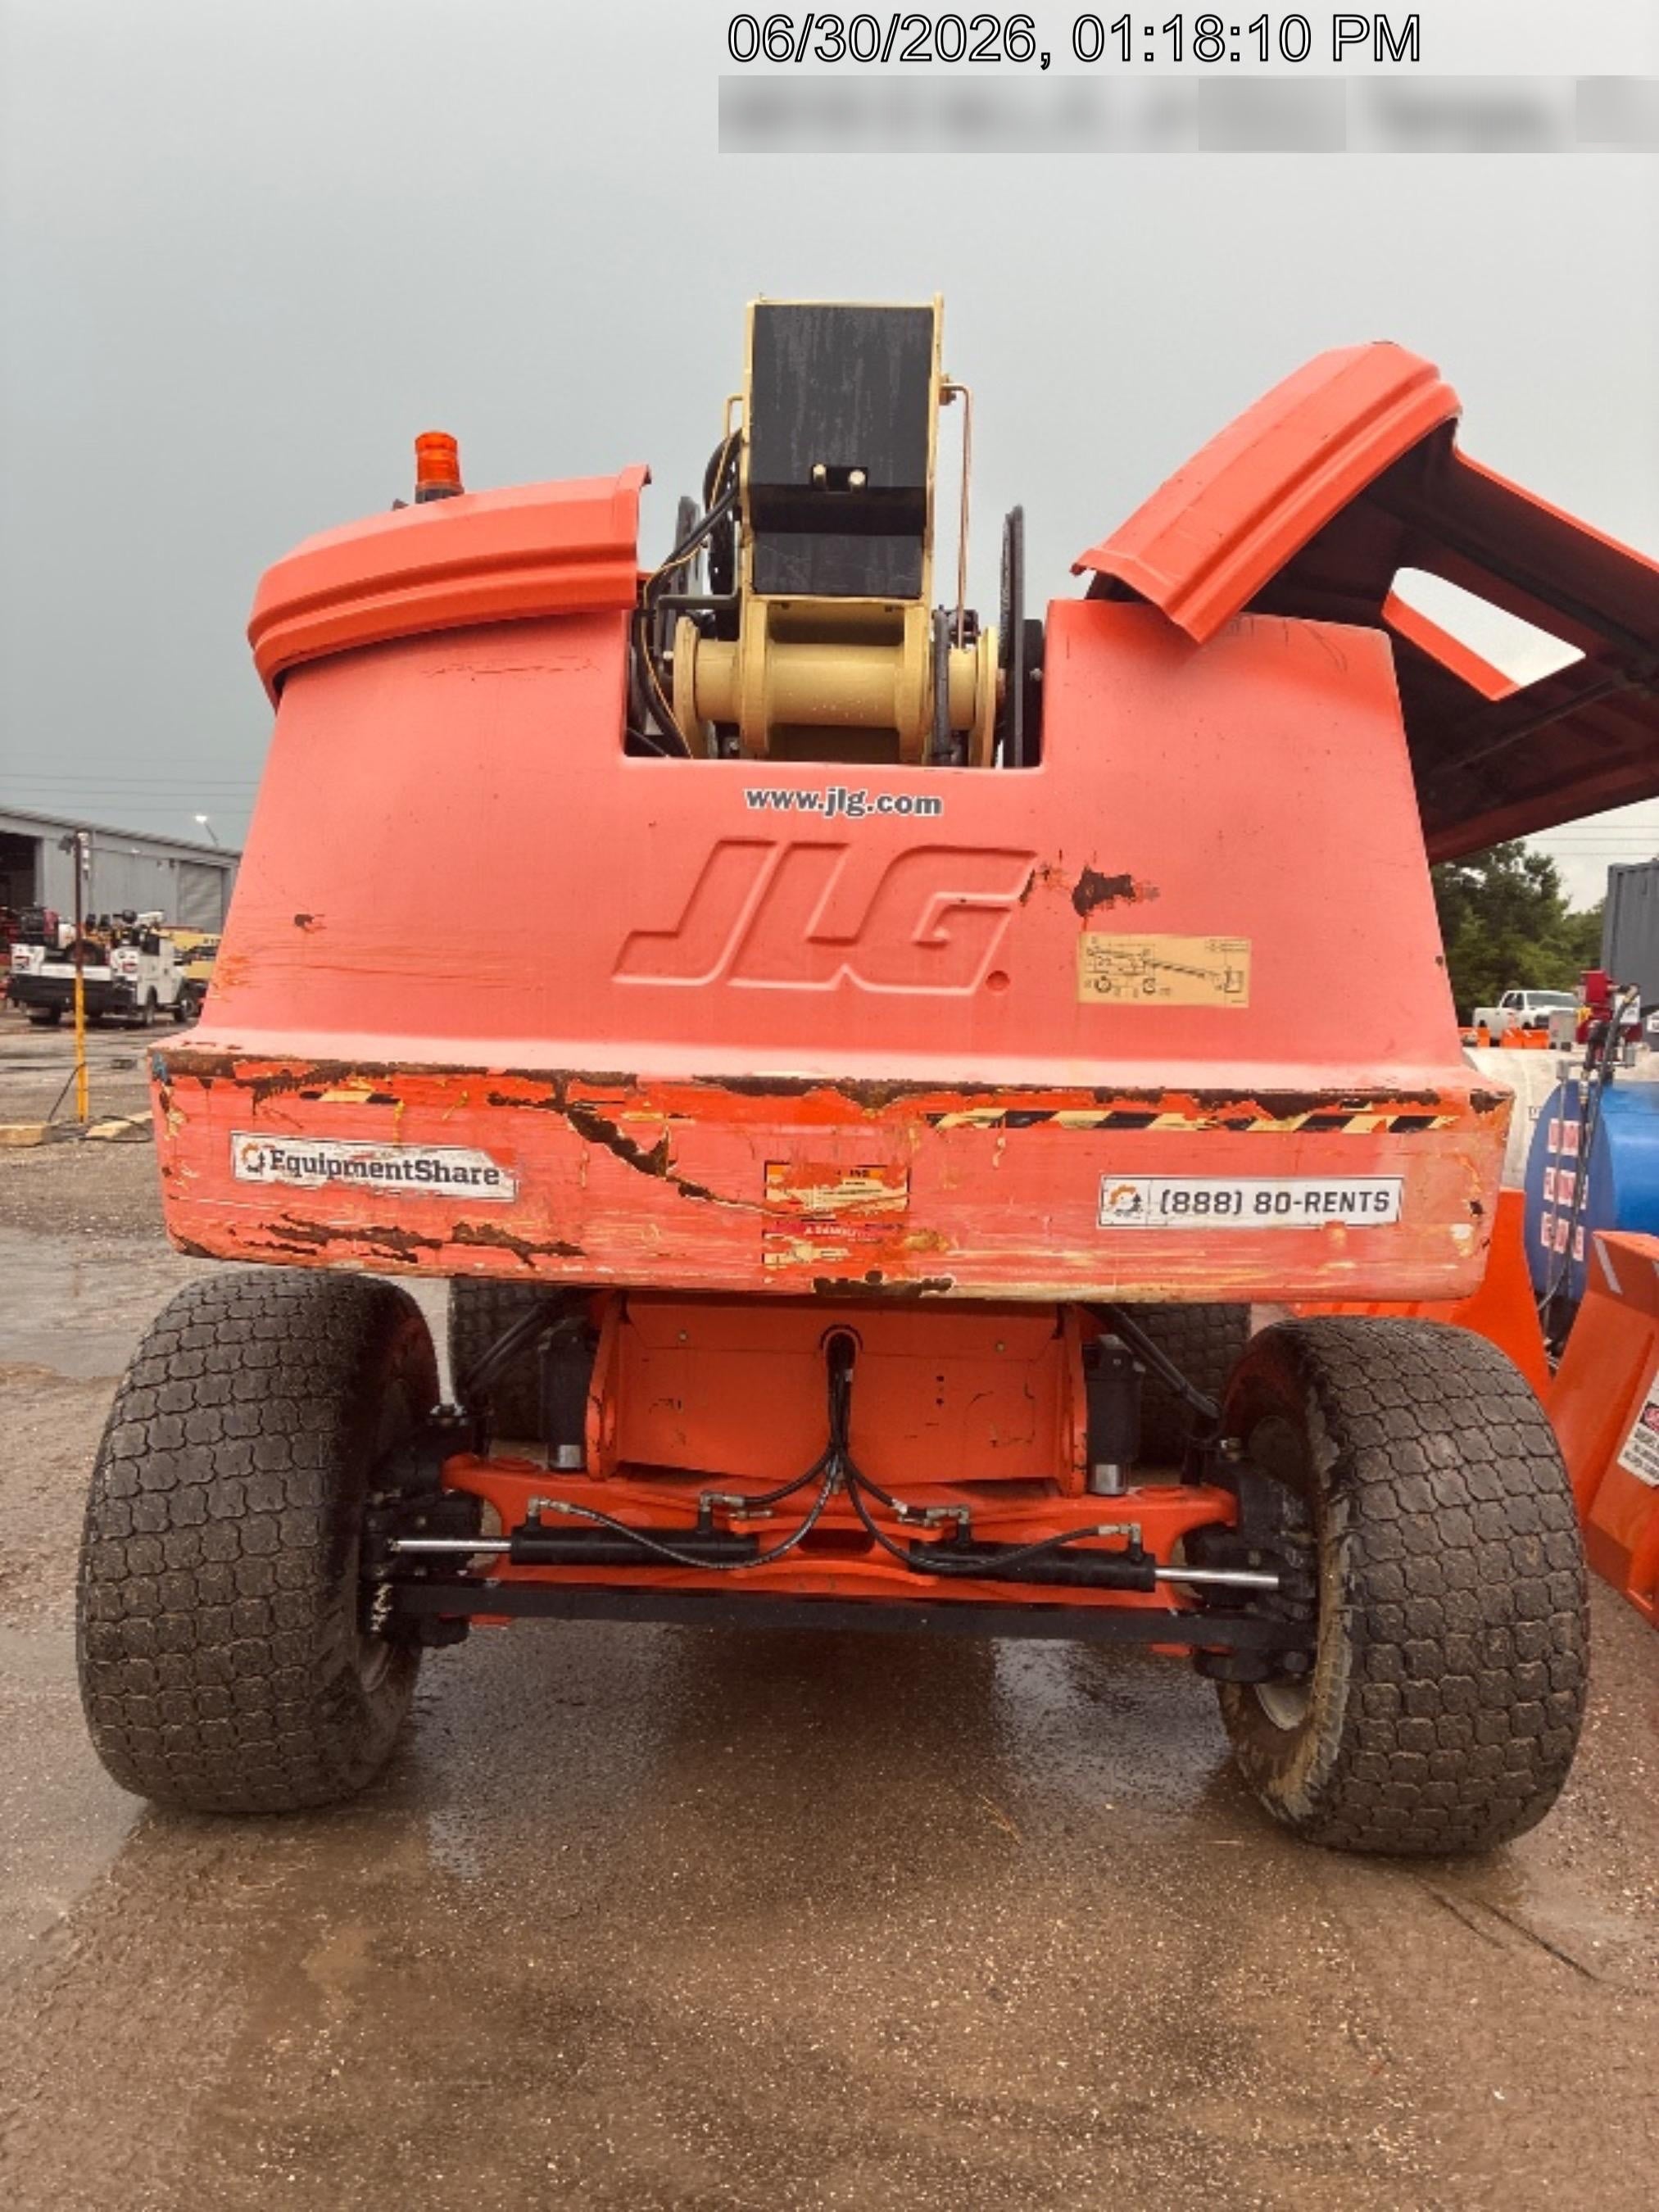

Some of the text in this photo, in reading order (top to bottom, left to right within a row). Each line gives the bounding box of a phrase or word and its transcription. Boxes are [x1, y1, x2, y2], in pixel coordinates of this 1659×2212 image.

[746, 787, 941, 817] www.jlg.com
[612, 837, 1038, 996] JLG
[270, 1149, 501, 1185] EquipmentShare
[1159, 1189, 1390, 1214] (888) 80-RENTS
